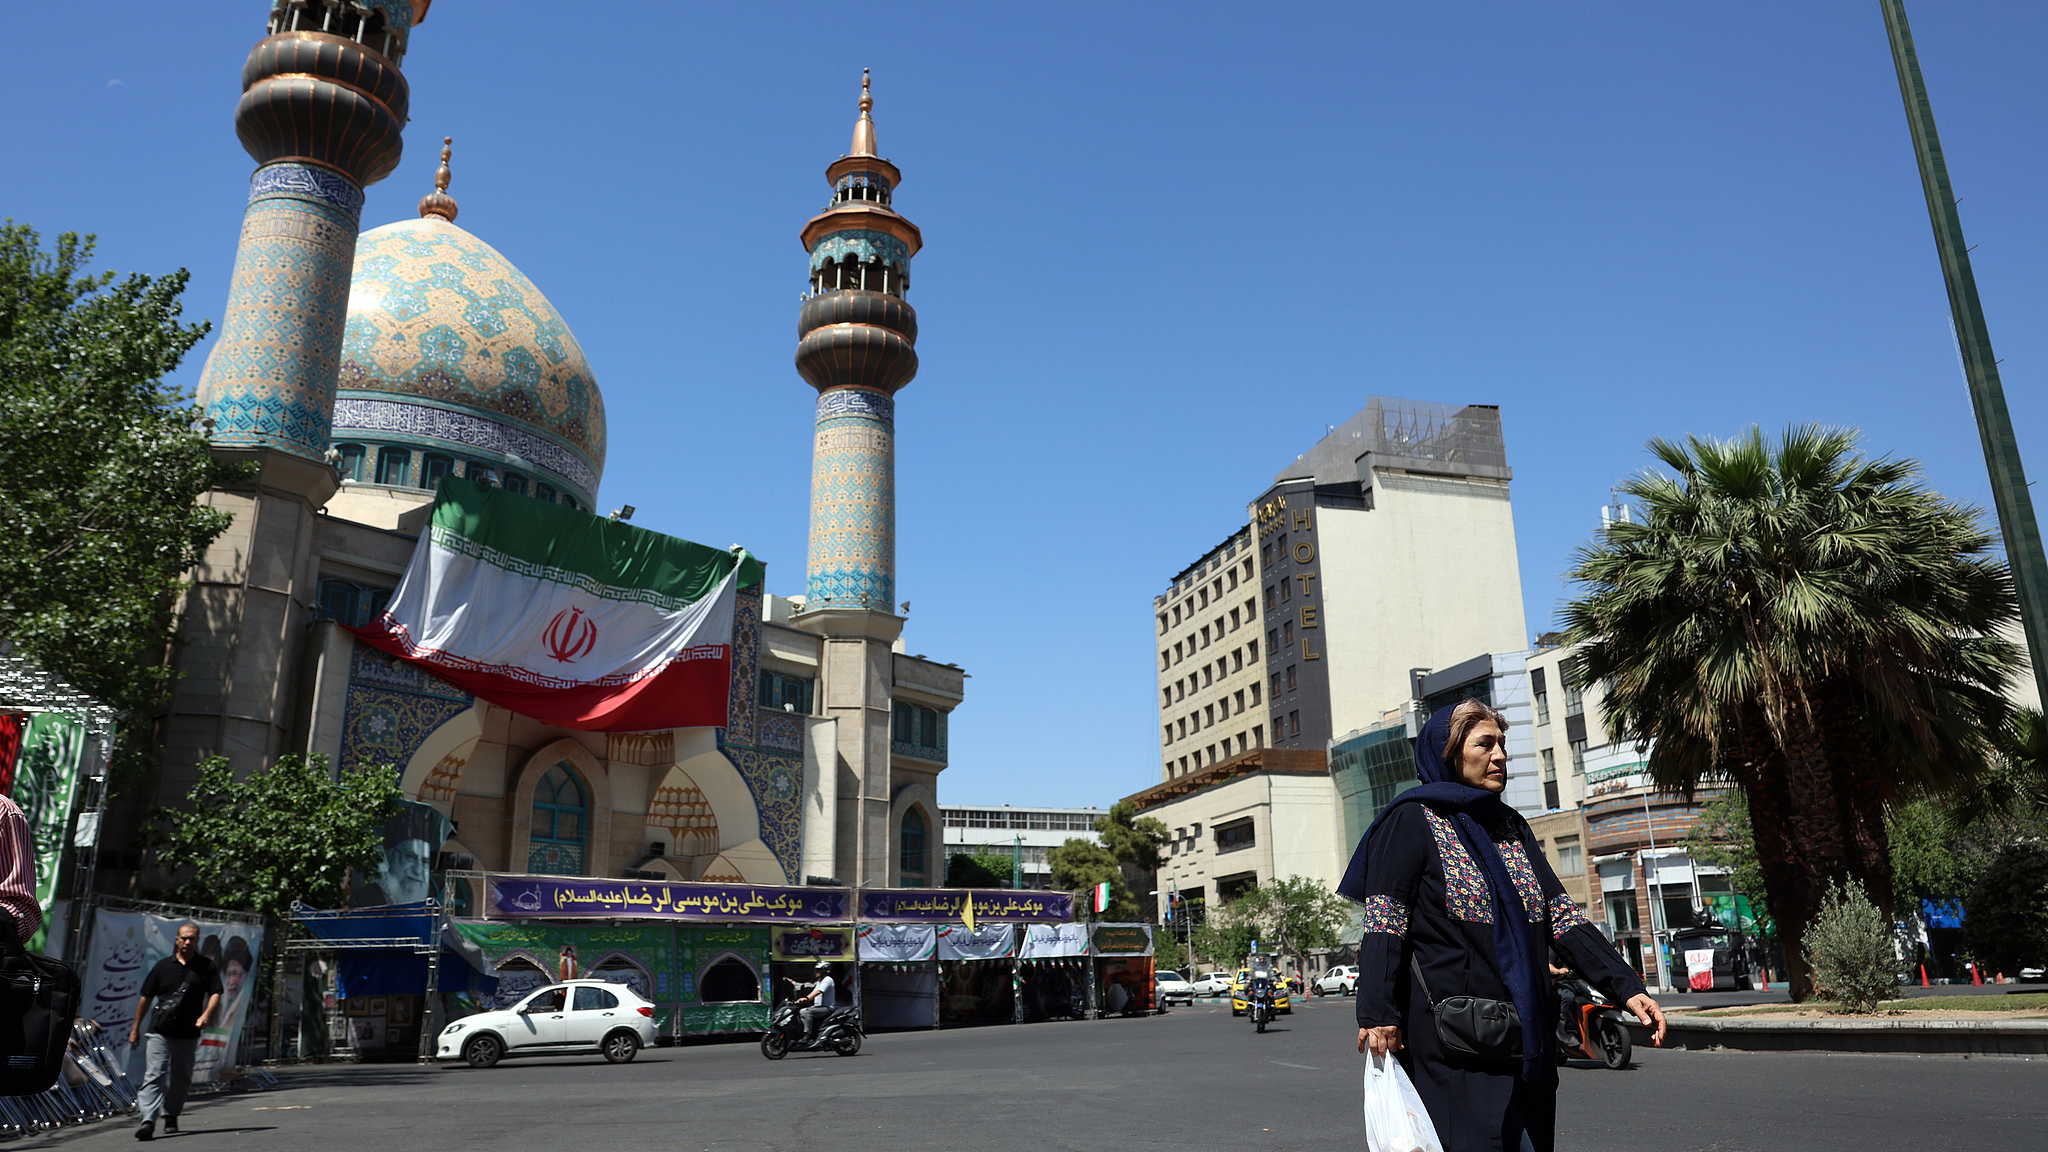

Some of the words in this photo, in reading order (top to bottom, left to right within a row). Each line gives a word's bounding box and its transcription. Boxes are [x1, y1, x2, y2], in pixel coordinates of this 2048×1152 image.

[1292, 508, 1320, 660] HOTEL
[624, 886, 671, 912] الرضا
[672, 895, 719, 914] موسی
[720, 892, 738, 914] بن
[738, 890, 766, 914] علی
[766, 894, 803, 916] موکب
[934, 896, 960, 916] الرضا
[988, 899, 1000, 916] بن
[1000, 898, 1018, 916] علی
[1018, 899, 1044, 916] موکب
